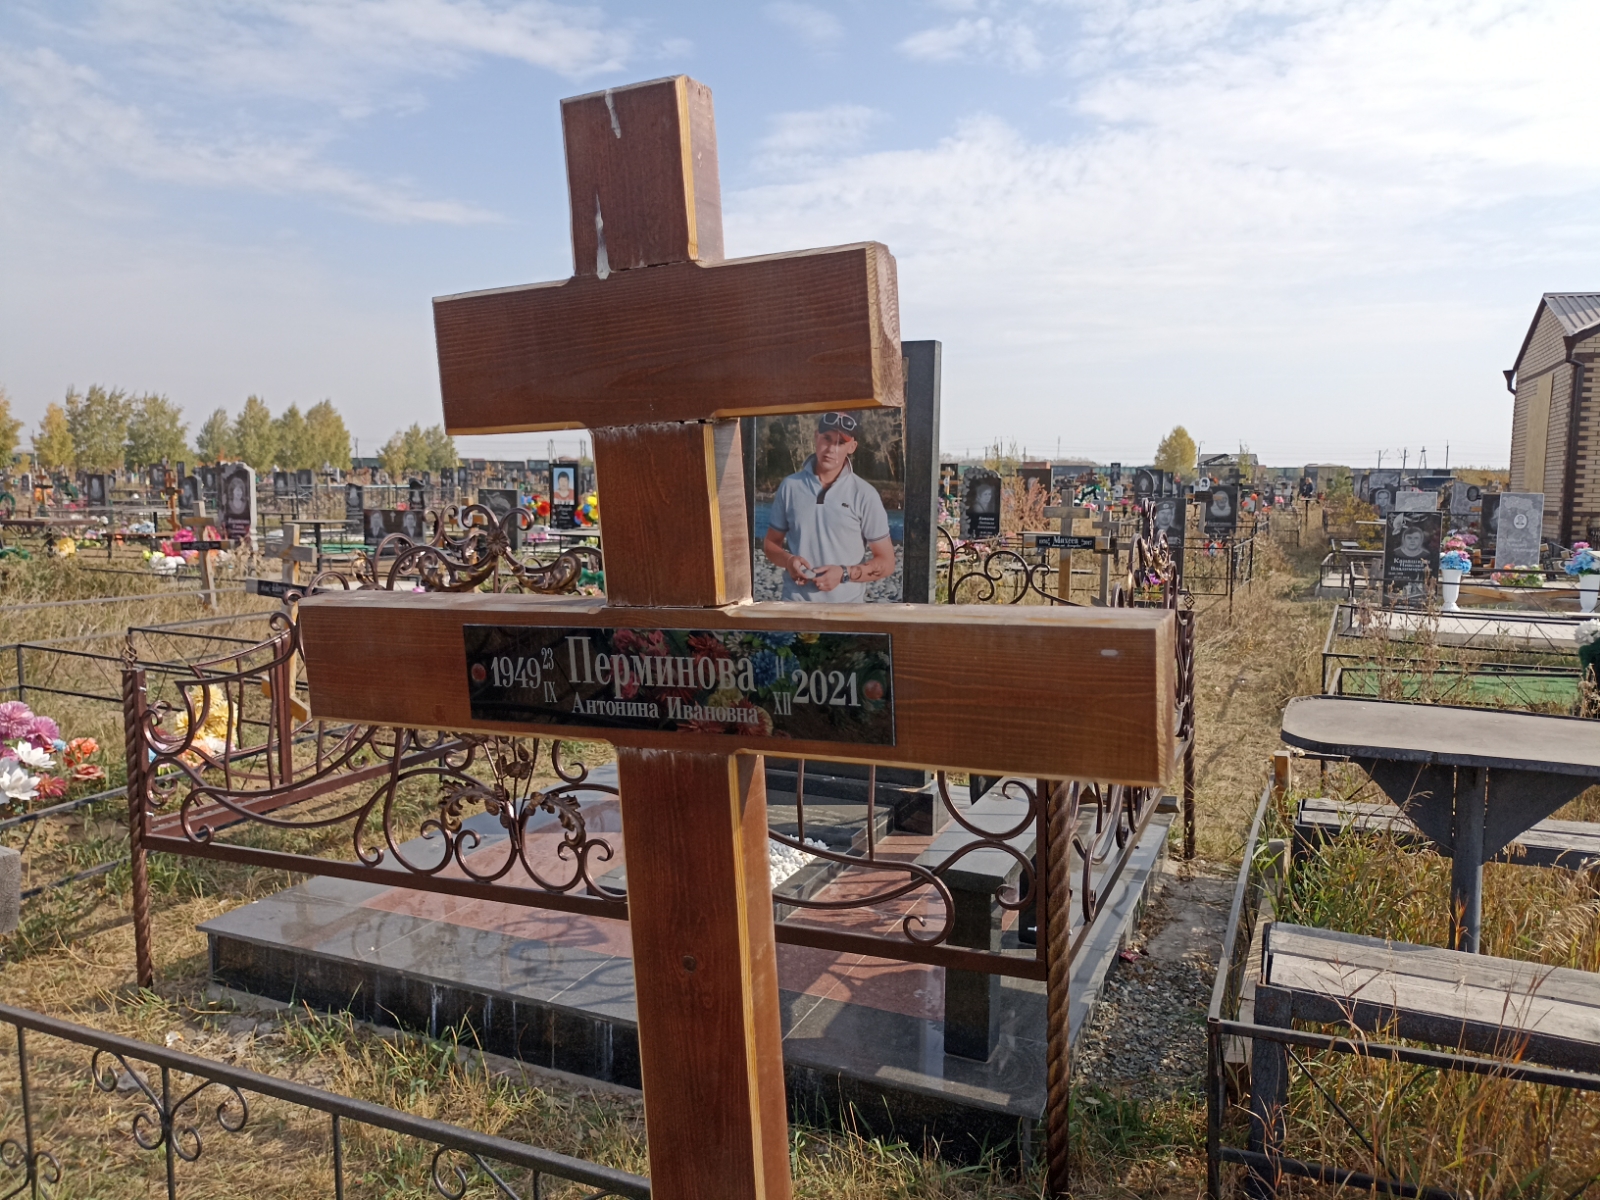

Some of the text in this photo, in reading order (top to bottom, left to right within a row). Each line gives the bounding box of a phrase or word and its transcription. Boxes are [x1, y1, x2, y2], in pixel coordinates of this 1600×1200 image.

[490, 656, 541, 689] 1949
[541, 647, 555, 670] 23
[565, 636, 757, 700] Перминова
[543, 681, 558, 703] IX
[791, 669, 861, 707] 2021
[572, 691, 760, 725] Антонина Ивановна
